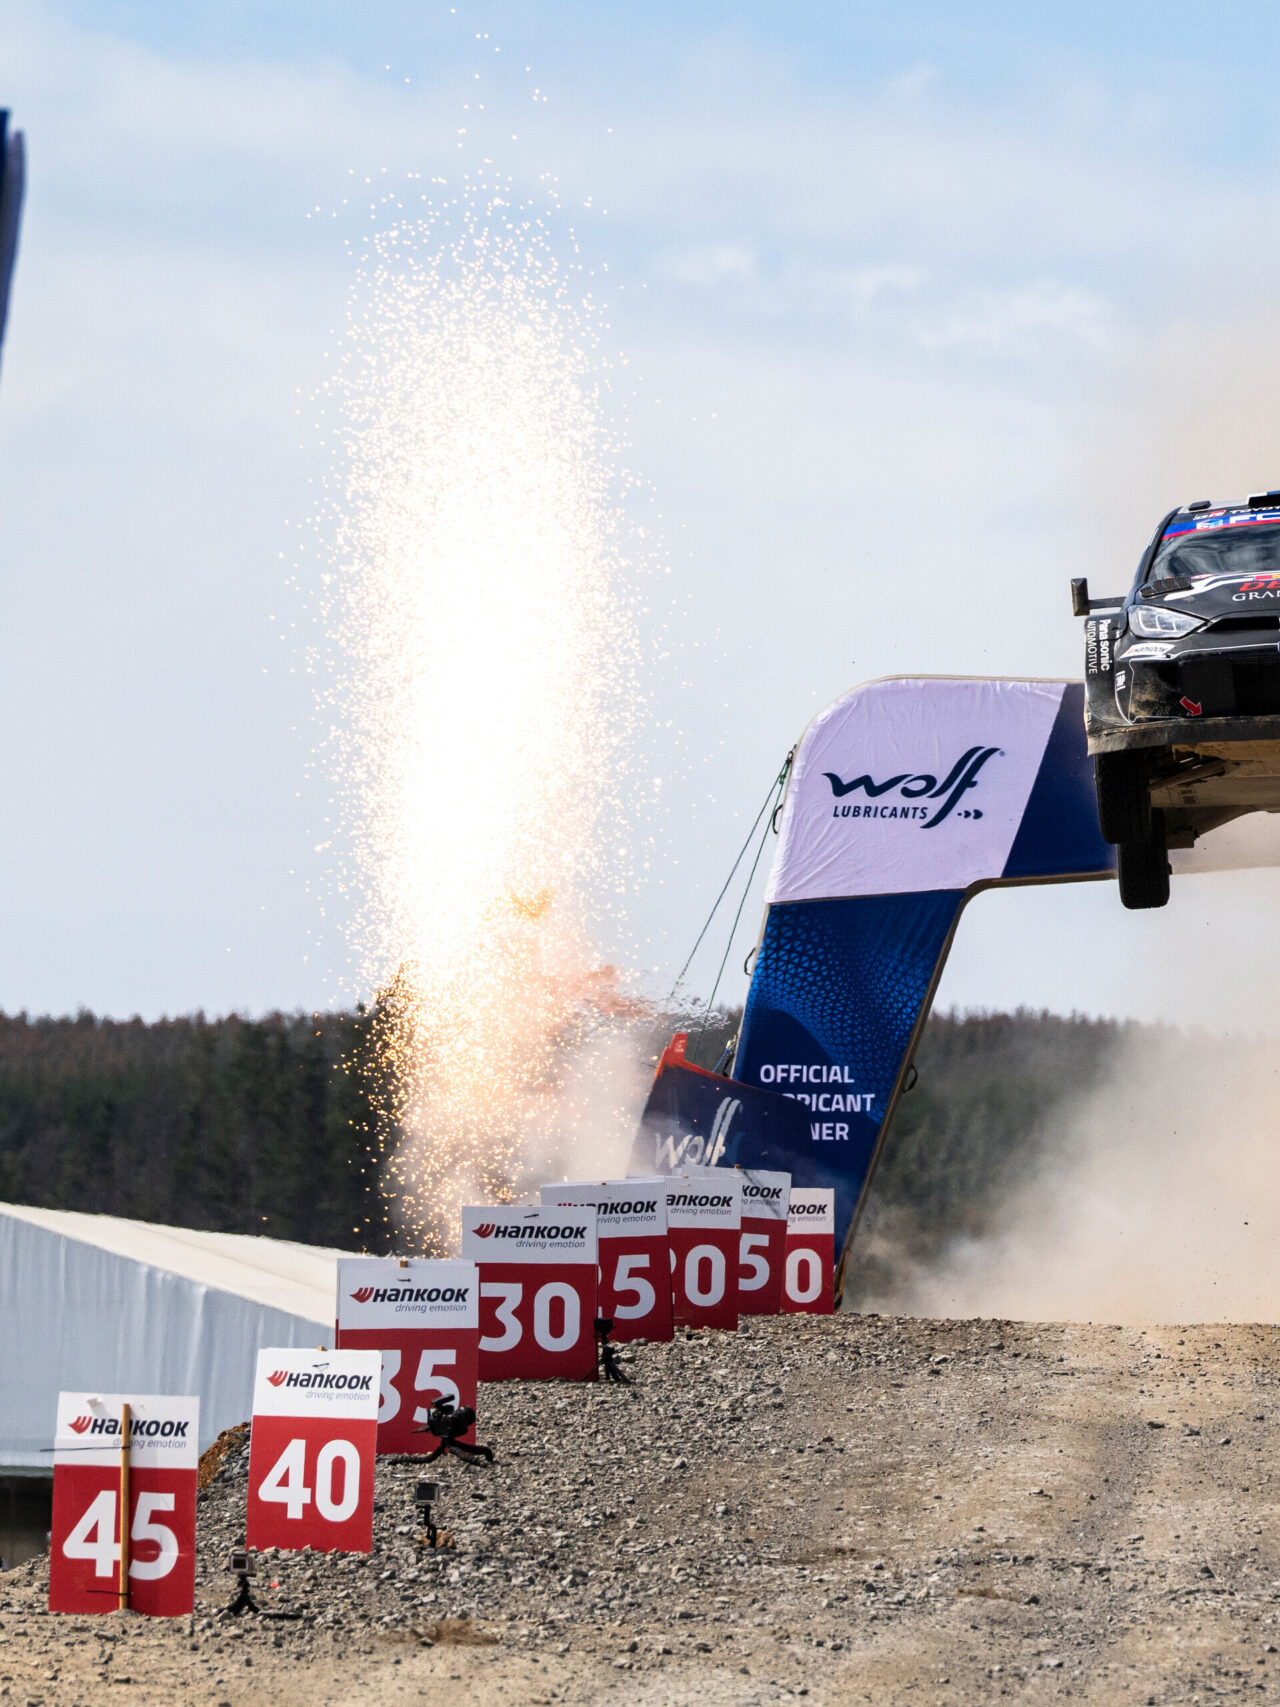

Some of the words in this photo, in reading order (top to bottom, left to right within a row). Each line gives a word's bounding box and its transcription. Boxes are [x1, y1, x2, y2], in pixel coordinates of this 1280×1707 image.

[1087, 620, 1098, 674] AUTOMOTIVE
[1099, 618, 1113, 671] Panasonic
[833, 805, 928, 820] LUBRICANTS
[760, 1064, 855, 1084] OFFICIAL
[780, 1093, 876, 1112] ICANT
[597, 1215, 620, 1224] riving
[622, 1214, 657, 1223] emotion
[671, 1207, 699, 1215] driving
[700, 1208, 732, 1216] emotion
[516, 1240, 547, 1249] driving
[549, 1240, 585, 1248] emotion
[738, 1233, 770, 1291] 5
[598, 1254, 656, 1320] 5
[670, 1244, 726, 1307] 0
[785, 1248, 822, 1304] 0
[395, 1304, 427, 1313] driving
[429, 1303, 467, 1312] emotion
[478, 1282, 581, 1352] 30
[306, 1391, 334, 1401] driving
[336, 1391, 370, 1401] emotion
[147, 1439, 187, 1448] emotion
[258, 1439, 360, 1522] 40
[62, 1490, 180, 1581] 45
